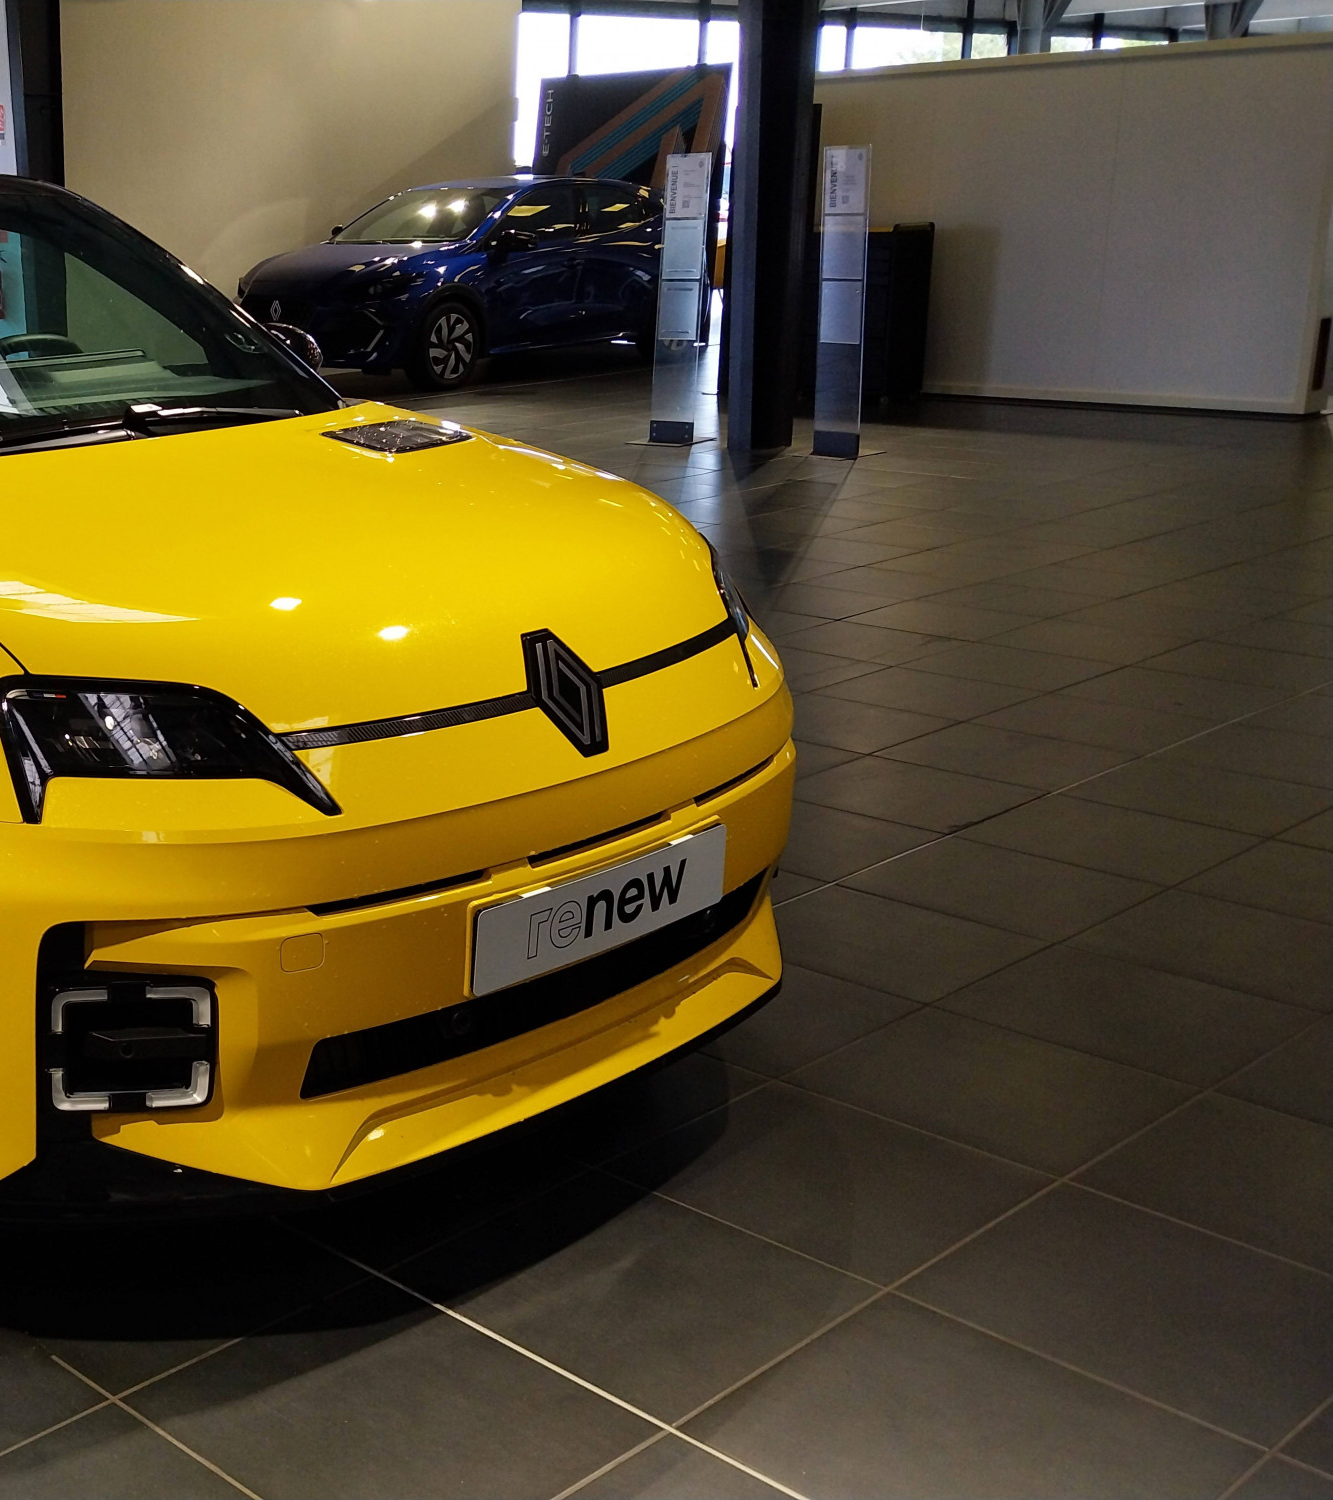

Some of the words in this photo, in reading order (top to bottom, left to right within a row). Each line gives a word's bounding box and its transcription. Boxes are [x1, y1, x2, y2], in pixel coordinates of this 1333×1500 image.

[542, 90, 554, 157] E-TECH
[669, 170, 678, 214] BIENVENUE
[527, 858, 687, 960] renew
